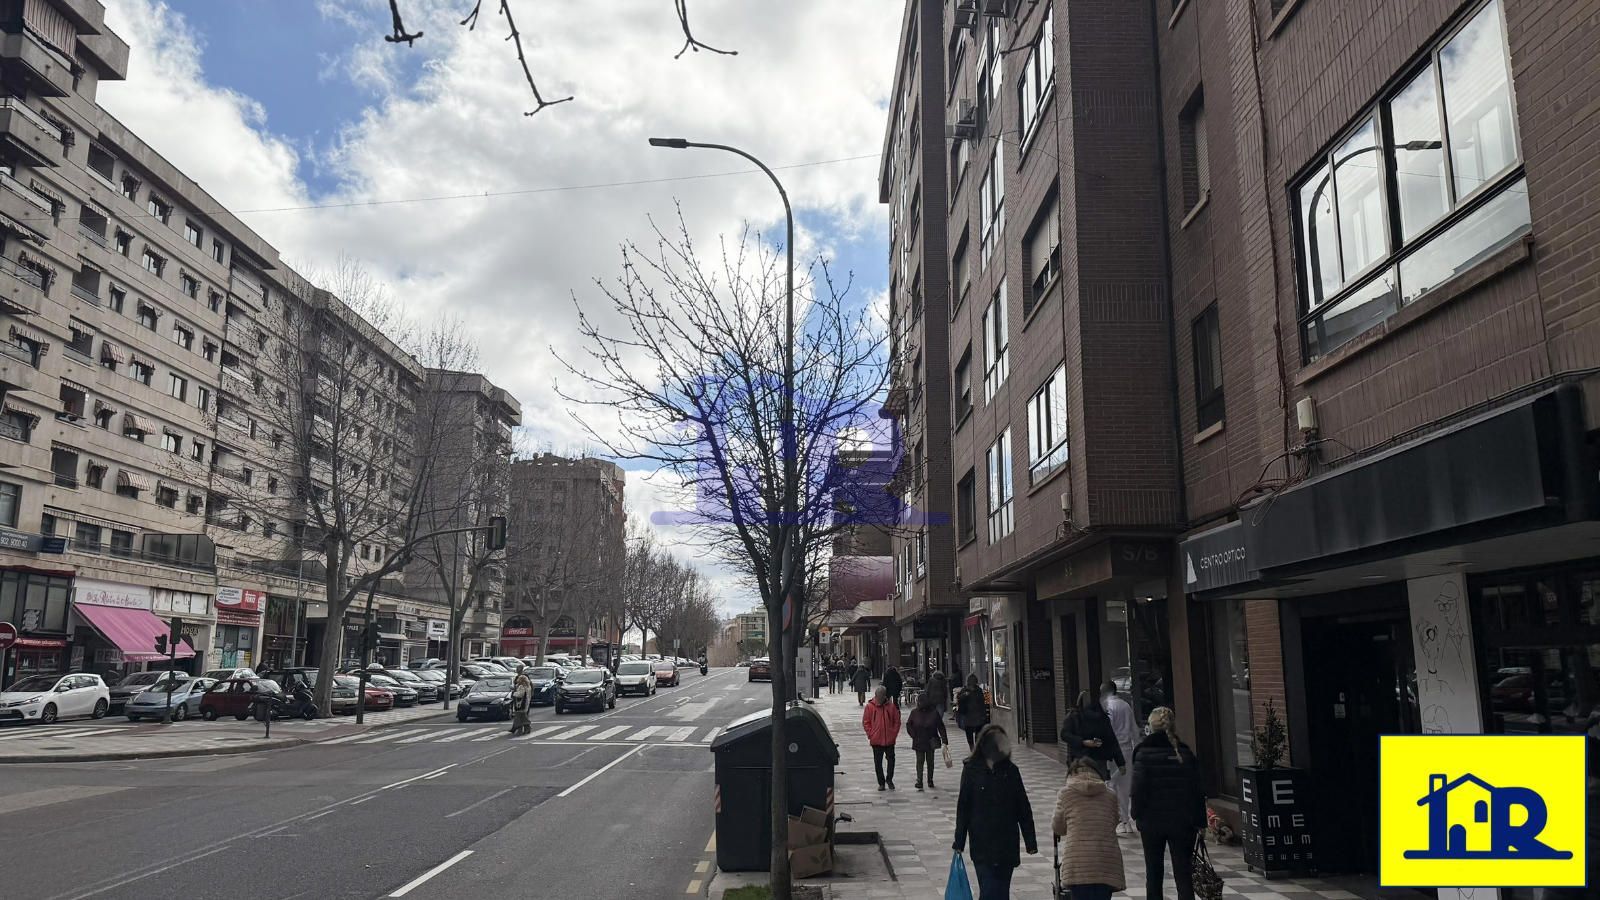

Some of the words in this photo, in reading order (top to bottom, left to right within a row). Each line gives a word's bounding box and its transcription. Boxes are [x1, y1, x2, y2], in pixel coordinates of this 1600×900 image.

[1200, 552, 1223, 569] CENTRO
[1224, 547, 1246, 563] OPTICO
[1271, 779, 1295, 804] E
